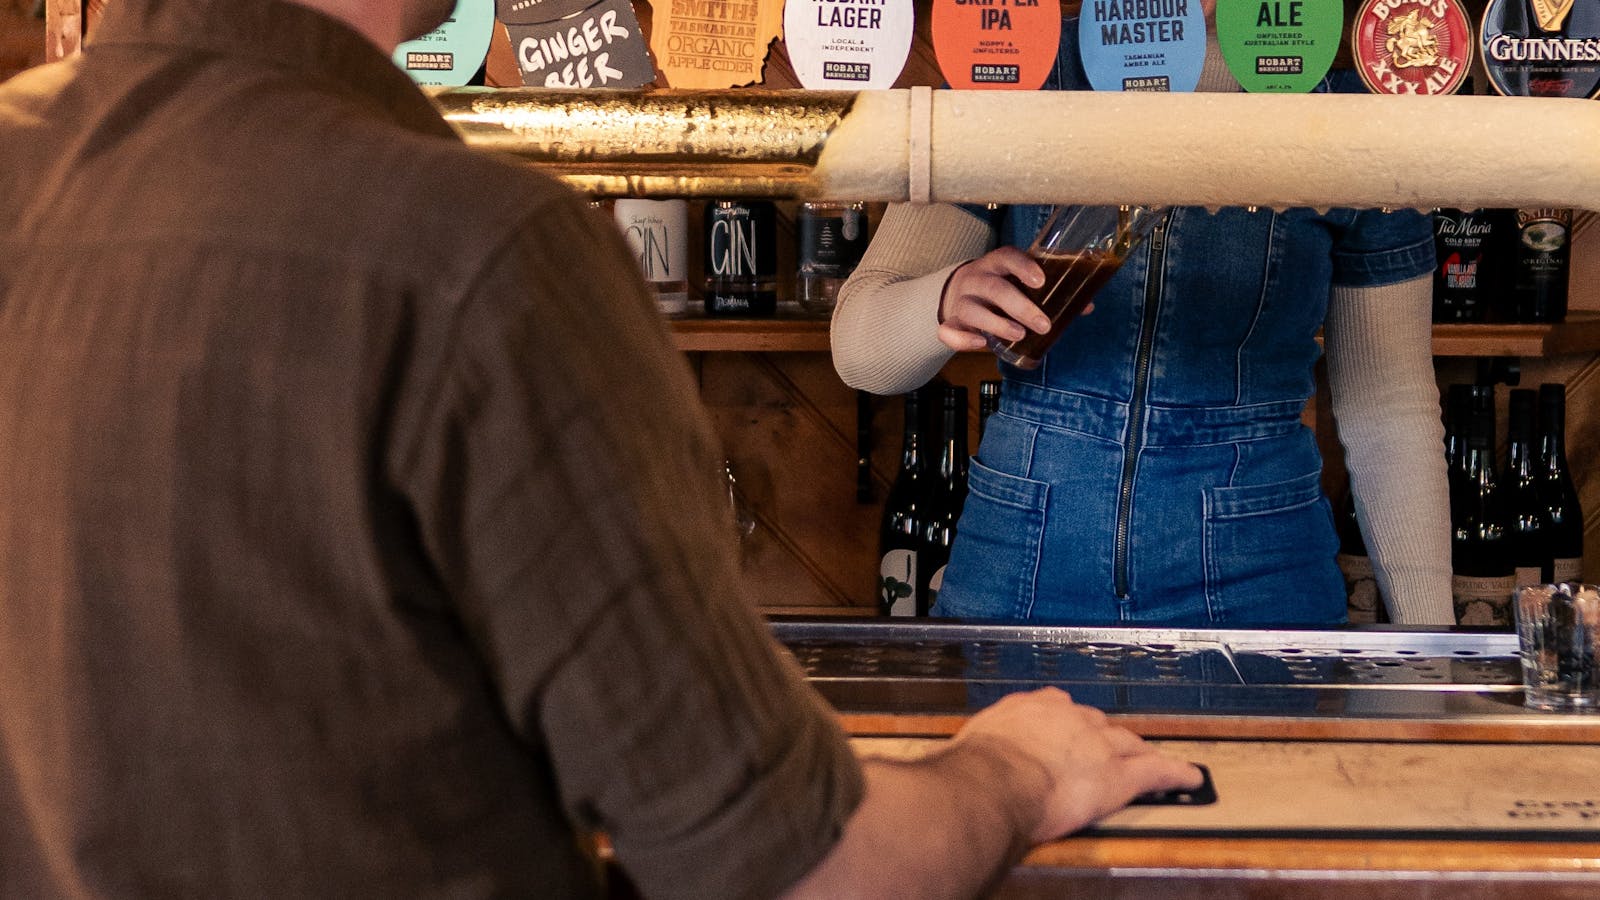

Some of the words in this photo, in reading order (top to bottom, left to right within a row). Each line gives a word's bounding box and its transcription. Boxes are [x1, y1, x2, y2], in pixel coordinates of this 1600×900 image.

[817, 5, 881, 29] LAGER
[981, 8, 1012, 30] IPA
[1094, 0, 1188, 22] HARBOUR
[1256, 2, 1303, 27] ALE
[670, 20, 756, 37] TASMANIAN
[1101, 20, 1184, 46] MASTER
[518, 9, 629, 73] GINGER
[667, 35, 755, 58] ORGANIC
[822, 45, 874, 53] INDEPENDENT
[408, 54, 452, 62] HOBART
[667, 56, 710, 69] APPLE
[712, 60, 753, 73] CIDER
[826, 63, 869, 73] HOBART
[1258, 58, 1301, 66] HOBART
[974, 66, 1017, 75] HOBART
[1125, 79, 1167, 87] HOBART
[1436, 216, 1457, 235] Tia
[1454, 218, 1492, 236] Maria
[711, 219, 756, 275] GIN
